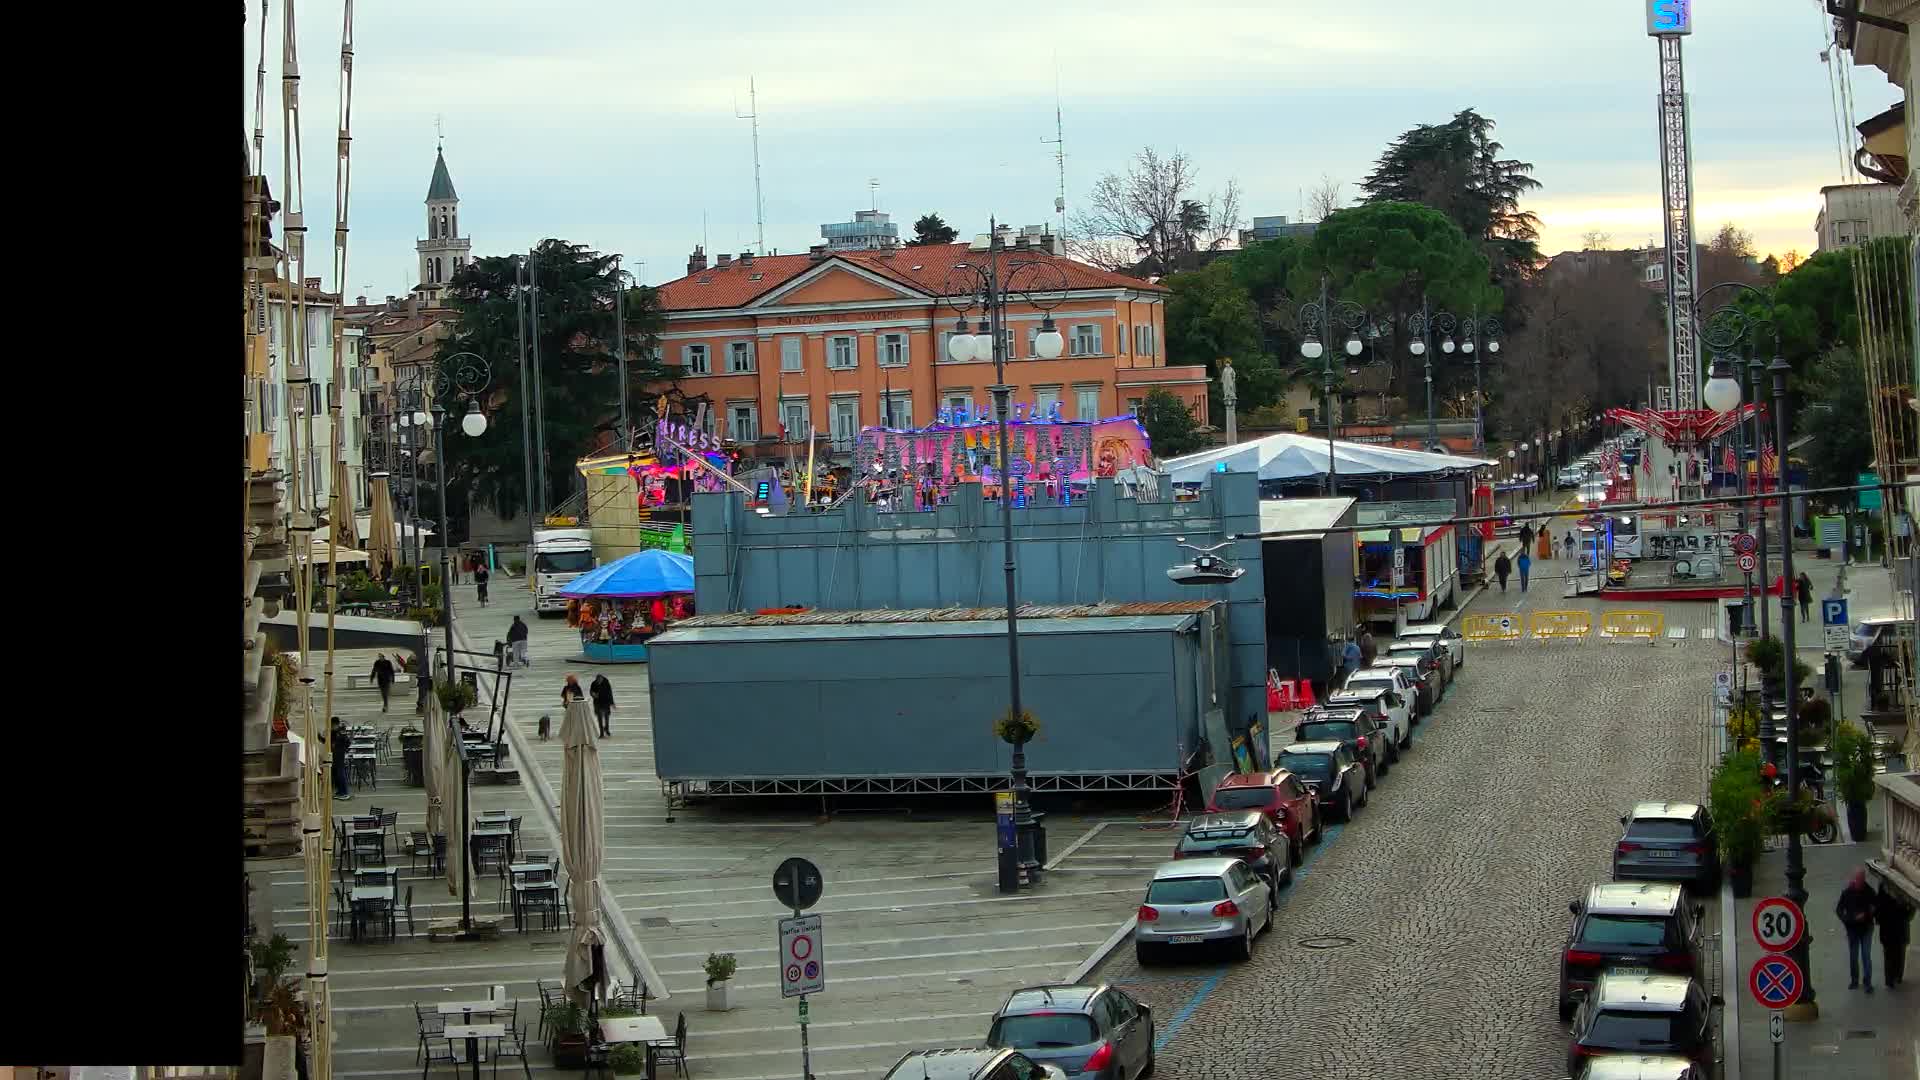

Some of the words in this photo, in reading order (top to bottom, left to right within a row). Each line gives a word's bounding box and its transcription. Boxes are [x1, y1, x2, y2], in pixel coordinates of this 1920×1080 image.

[1742, 558, 1753, 567] 20
[1826, 602, 1842, 622] P
[1762, 911, 1792, 938] 30
